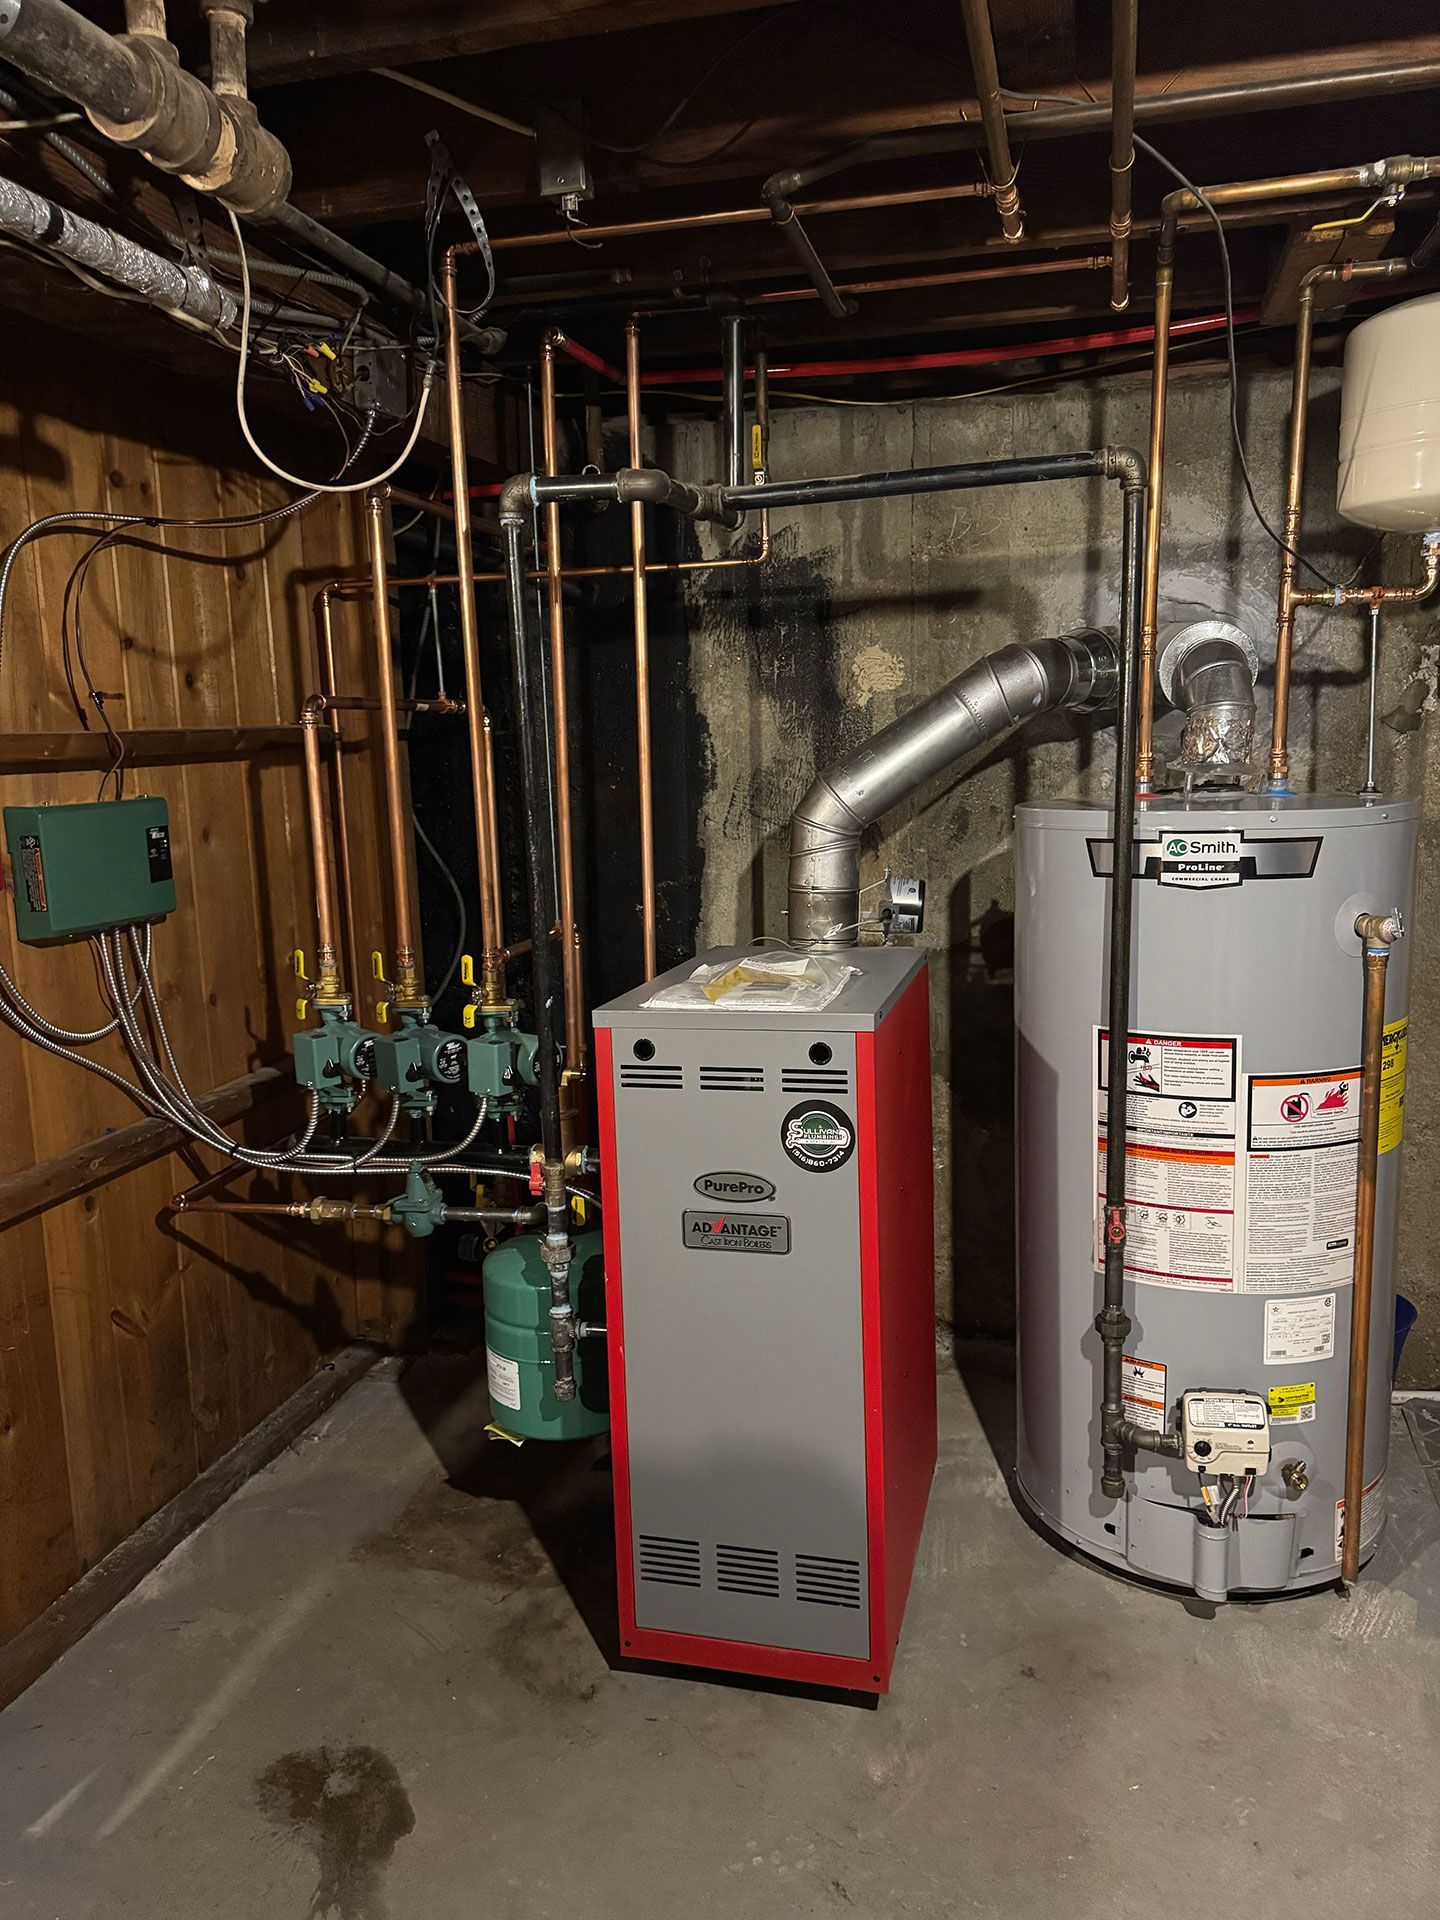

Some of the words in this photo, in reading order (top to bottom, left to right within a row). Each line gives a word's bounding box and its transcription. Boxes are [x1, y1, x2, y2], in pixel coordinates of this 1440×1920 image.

[1177, 863, 1224, 872] ProLine
[1153, 1039, 1182, 1047] DANGER
[704, 1179, 765, 1195] PurePro
[701, 1235, 722, 1245] CAST
